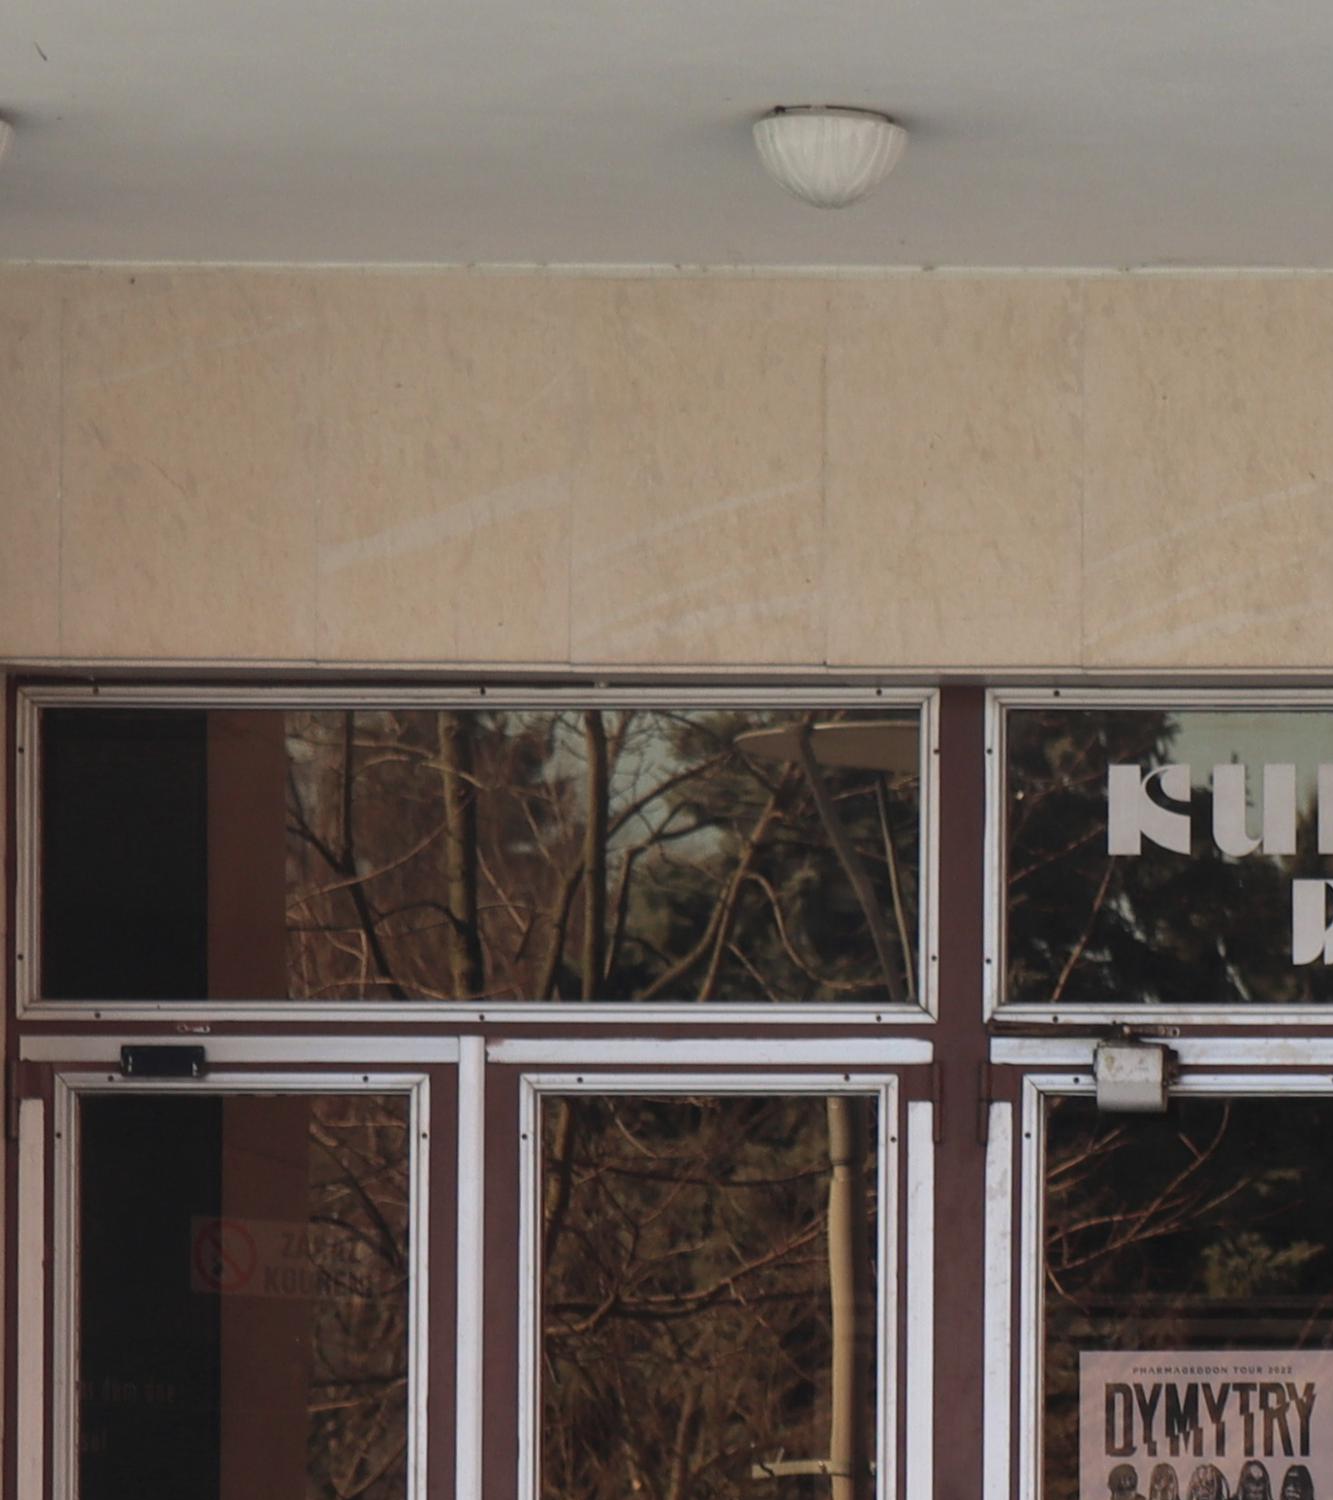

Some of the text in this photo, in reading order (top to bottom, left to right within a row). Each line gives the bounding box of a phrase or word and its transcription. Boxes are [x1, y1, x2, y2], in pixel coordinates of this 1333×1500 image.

[1133, 1366, 1292, 1375] PHARMAGEDDON TOUR 2022
[1105, 1382, 1316, 1457] DYMYTRY
